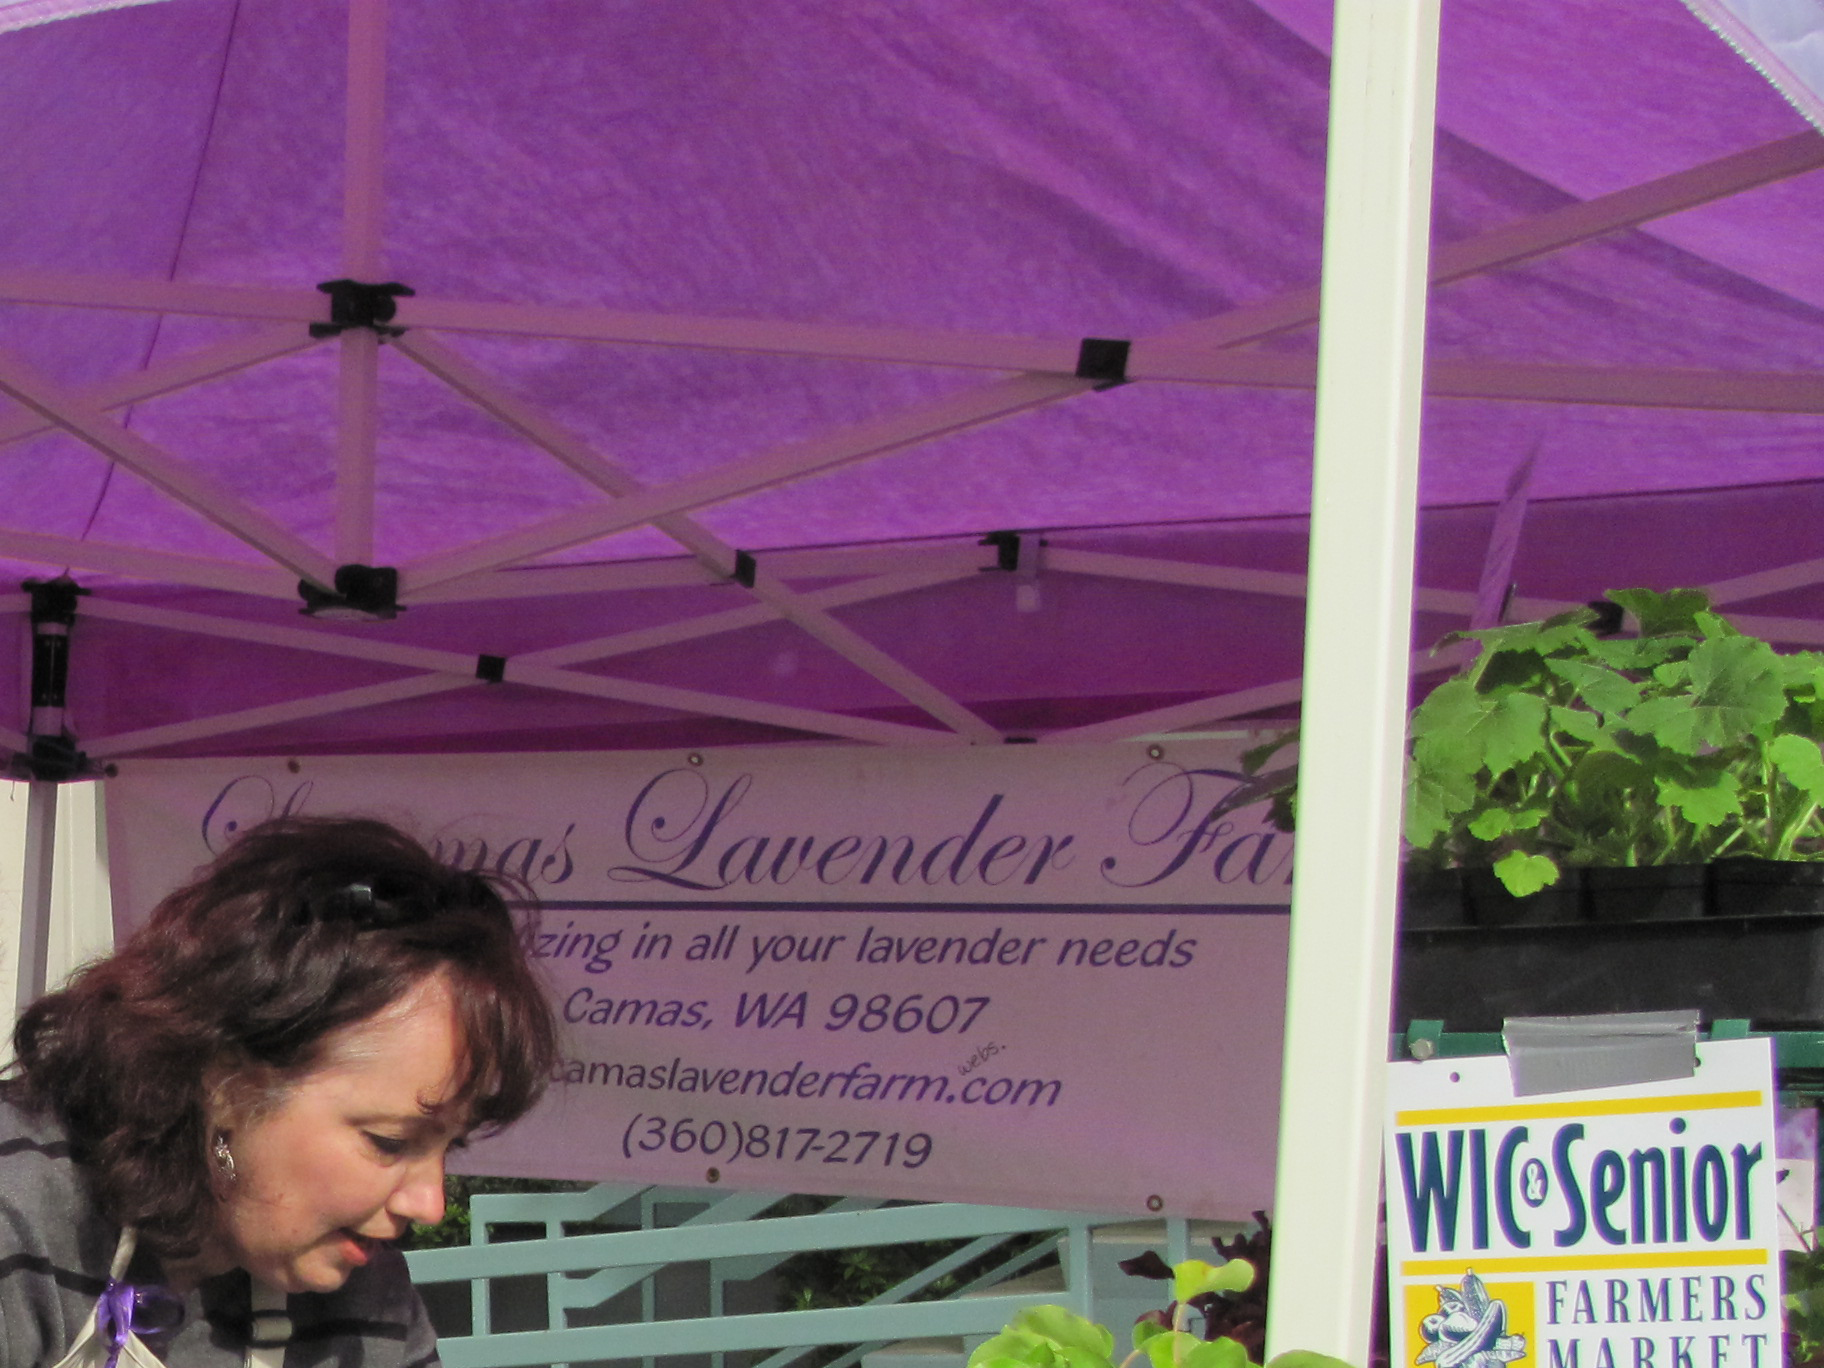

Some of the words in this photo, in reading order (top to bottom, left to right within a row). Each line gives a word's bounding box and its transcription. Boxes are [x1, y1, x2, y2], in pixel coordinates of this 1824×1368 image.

[607, 768, 1075, 891] Lavender
[1100, 762, 1296, 888] Fa
[632, 921, 673, 960] in
[685, 925, 740, 960] all
[746, 934, 845, 974] your
[856, 926, 1047, 965] lavender
[1057, 929, 1198, 968] needs
[564, 987, 713, 1030] Camas,
[735, 991, 808, 1029] WA
[825, 992, 990, 1034] 98607
[622, 1113, 932, 1168] (360)817-2719
[1395, 1125, 1531, 1253] WIC
[1521, 1160, 1547, 1205] &
[1552, 1117, 1762, 1248] Senior
[1546, 1274, 1767, 1325] FARMERS
